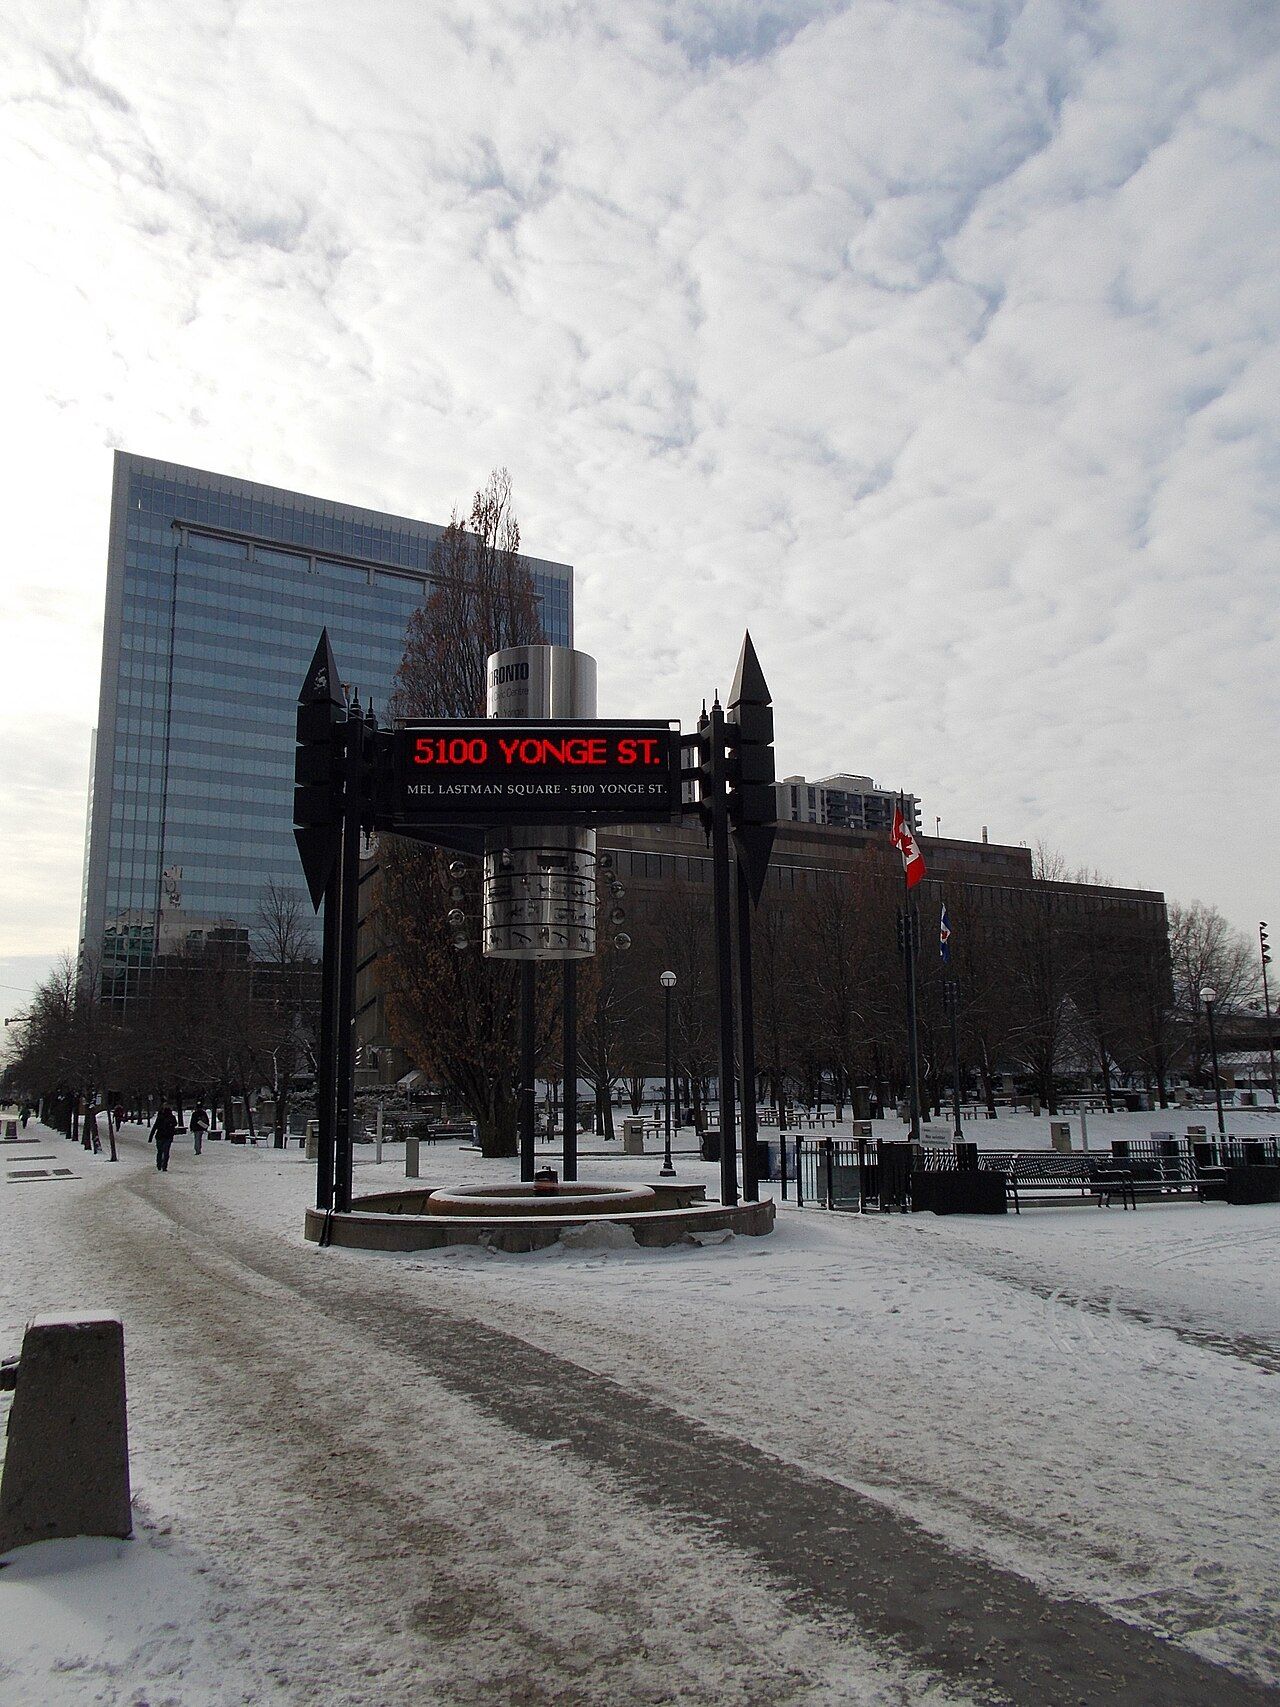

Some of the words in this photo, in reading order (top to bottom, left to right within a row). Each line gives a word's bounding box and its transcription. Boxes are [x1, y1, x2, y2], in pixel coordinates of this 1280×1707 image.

[414, 738, 488, 764] 5100
[499, 738, 607, 764] YONGE
[617, 738, 661, 764] ST.
[407, 784, 435, 795] MEL
[438, 784, 503, 795] LASTMAN
[507, 784, 561, 796] SQUARE
[570, 784, 595, 794] 5100
[599, 783, 645, 795] YONGE
[648, 783, 667, 794] ST.
